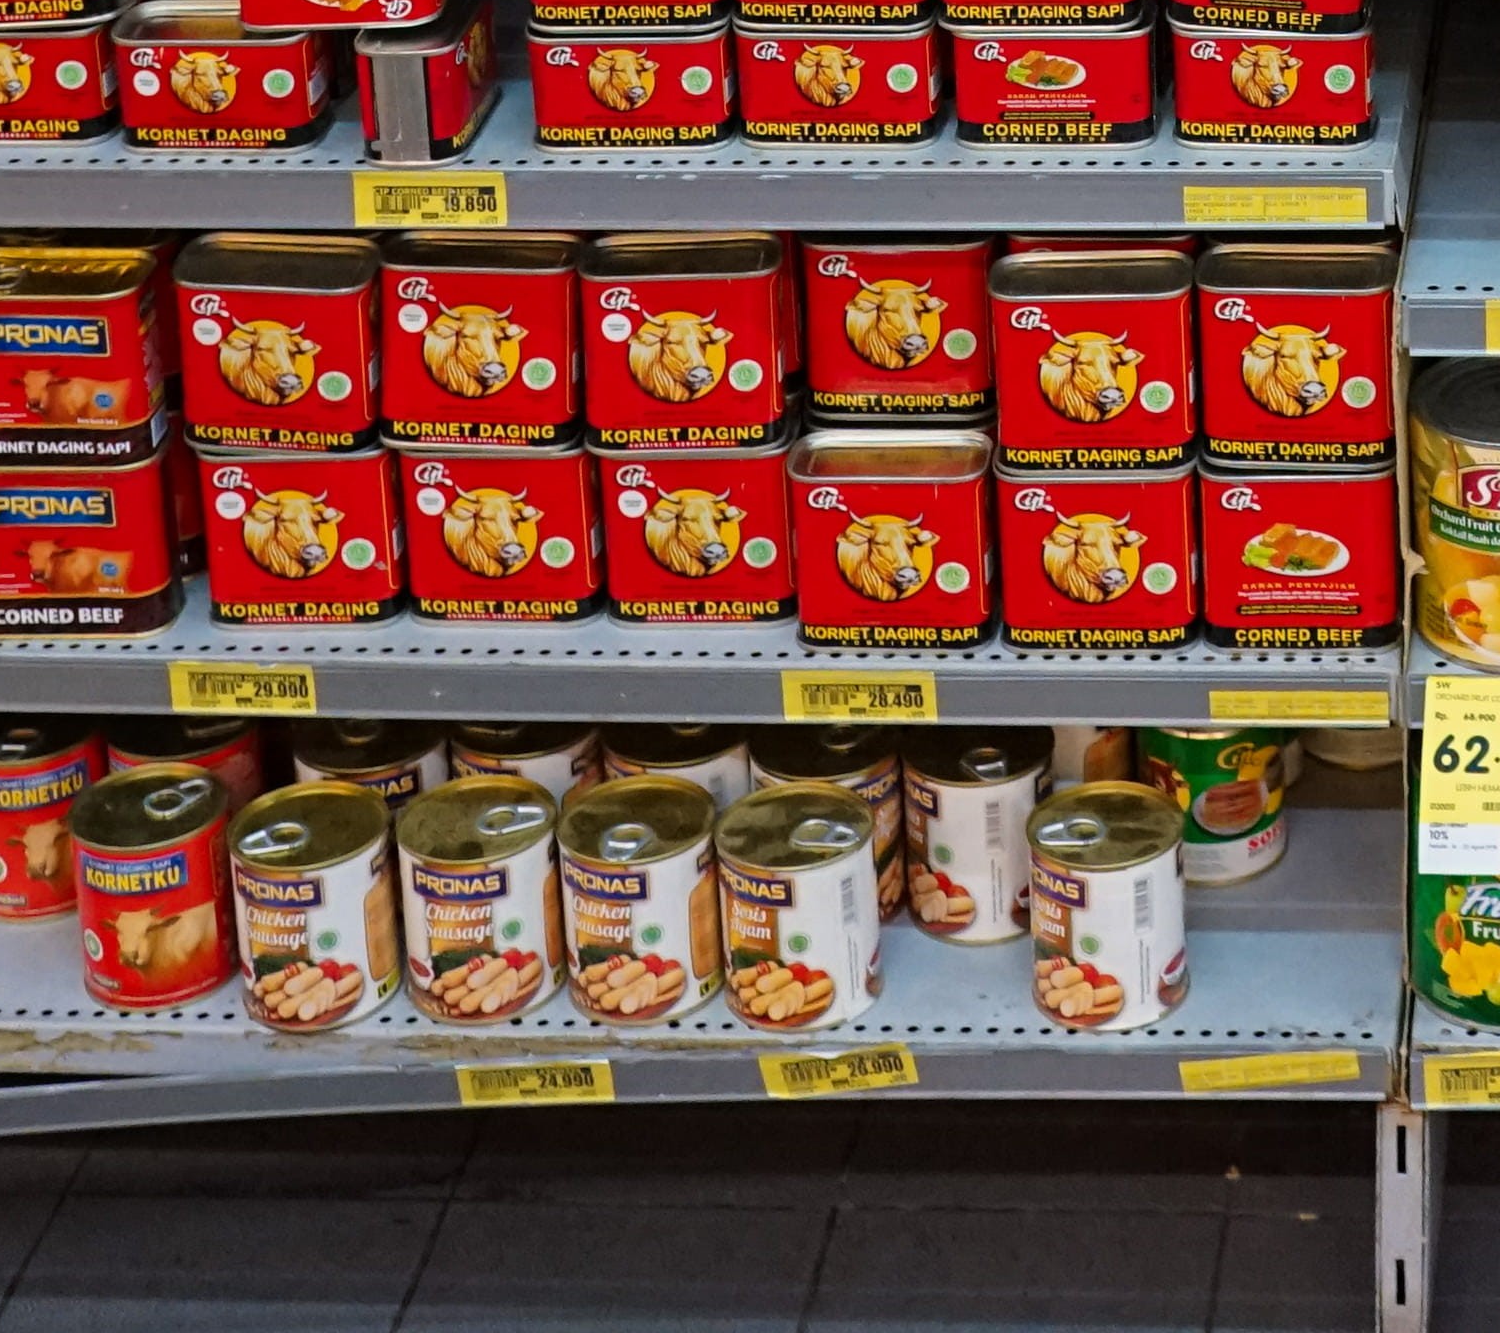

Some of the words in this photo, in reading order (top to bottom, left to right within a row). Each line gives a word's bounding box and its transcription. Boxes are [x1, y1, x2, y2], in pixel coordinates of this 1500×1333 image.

[11, 119, 78, 132] DAGING
[441, 197, 498, 213] 19.890
[254, 682, 309, 699] 29.990
[868, 691, 923, 710] 28.490
[86, 866, 180, 889] KORNETKU
[246, 907, 306, 928] Chicken
